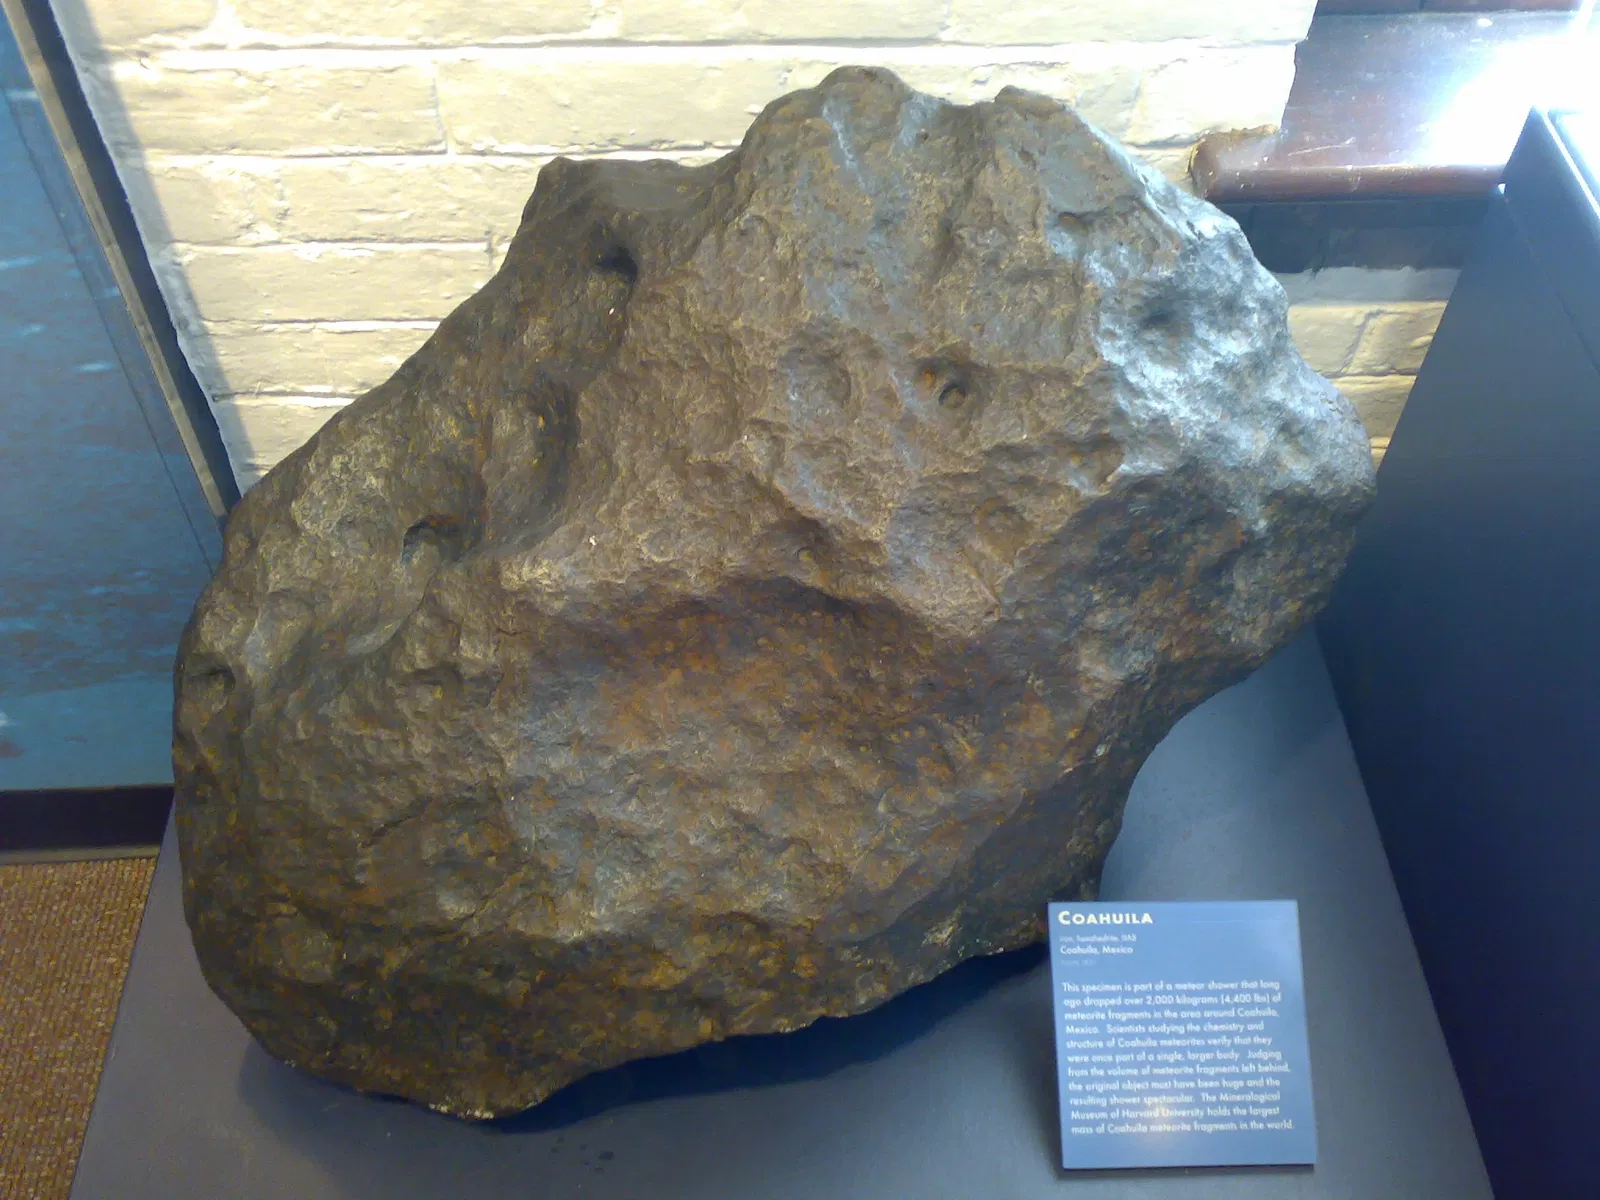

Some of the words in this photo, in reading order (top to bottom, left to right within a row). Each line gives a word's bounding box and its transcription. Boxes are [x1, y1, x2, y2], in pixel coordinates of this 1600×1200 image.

[1060, 946, 1099, 955] Coahuila,
[1102, 946, 1133, 954] Mexico
[1062, 982, 1080, 992] This
[1082, 982, 1122, 993] specimen
[1125, 982, 1132, 991] is
[1134, 982, 1152, 993] part
[1155, 981, 1164, 991] of
[1166, 983, 1172, 991] a
[1175, 982, 1204, 990] meteor
[1208, 980, 1238, 990] shower
[1241, 980, 1258, 989] that
[1260, 980, 1280, 991] long
[1064, 997, 1082, 1007] ago
[1083, 995, 1121, 1006] dropped
[1124, 997, 1144, 1005] over
[1146, 996, 1174, 1006] 2,000
[1175, 994, 1218, 1006] kilograms
[1220, 993, 1251, 1005] (4,400
[1272, 992, 1281, 1003] of
[1064, 1011, 1106, 1021] meteorite
[1108, 1009, 1151, 1021] fragments
[1153, 1010, 1161, 1019] in
[1164, 1009, 1178, 1018] the
[1203, 1008, 1235, 1018] around
[1238, 1007, 1279, 1018] Coahuila,
[1065, 1024, 1100, 1034] Mexico.
[1107, 1023, 1146, 1034] Scientists
[1148, 1023, 1185, 1035] studying
[1187, 1023, 1201, 1032] the
[1203, 1022, 1245, 1033] chemistry
[1247, 1021, 1264, 1030] and
[1066, 1039, 1103, 1049] structure
[1106, 1038, 1116, 1048] of
[1118, 1038, 1157, 1048] Coahuila
[1160, 1037, 1205, 1047] meteorites
[1207, 1036, 1232, 1047] verify
[1234, 1036, 1252, 1045] that
[1253, 1035, 1272, 1046] they
[1067, 1055, 1089, 1063] were
[1092, 1054, 1113, 1063] once
[1115, 1052, 1134, 1064] part
[1137, 1051, 1146, 1061] of
[1156, 1052, 1185, 1062] single,
[1188, 1051, 1214, 1063] larger
[1247, 1049, 1282, 1061] Judging
[1067, 1067, 1088, 1077] from
[1090, 1066, 1105, 1076] the
[1107, 1066, 1139, 1076] volume
[1141, 1065, 1151, 1075] of
[1152, 1065, 1195, 1075] meteorite
[1196, 1063, 1239, 1075] fragments
[1242, 1063, 1256, 1073] left
[1068, 1081, 1083, 1091] the
[1086, 1080, 1120, 1092] original
[1122, 1079, 1149, 1091] object
[1151, 1079, 1172, 1089] must
[1174, 1078, 1195, 1088] have
[1198, 1078, 1221, 1088] been
[1223, 1078, 1244, 1088] huge
[1246, 1077, 1264, 1087] and
[1266, 1077, 1281, 1087] the
[1069, 1094, 1108, 1107] resulting
[1110, 1094, 1141, 1105] shower
[1143, 1092, 1195, 1106] spectacular.
[1200, 1092, 1216, 1102] The
[1219, 1091, 1281, 1103] Mineralogical
[1071, 1109, 1108, 1120] Museum
[1111, 1108, 1120, 1118] of
[1122, 1107, 1159, 1118] Harvard
[1161, 1107, 1205, 1118] University
[1207, 1106, 1231, 1117] holds
[1233, 1105, 1247, 1115] the
[1249, 1105, 1280, 1117] largest
[1071, 1125, 1094, 1135] mass
[1096, 1124, 1105, 1133] of
[1108, 1123, 1147, 1133] Coahuila
[1150, 1121, 1192, 1133] meteorite
[1194, 1120, 1237, 1133] fragments
[1239, 1121, 1248, 1130] in
[1250, 1120, 1265, 1130] the
[1267, 1119, 1293, 1129] world.
